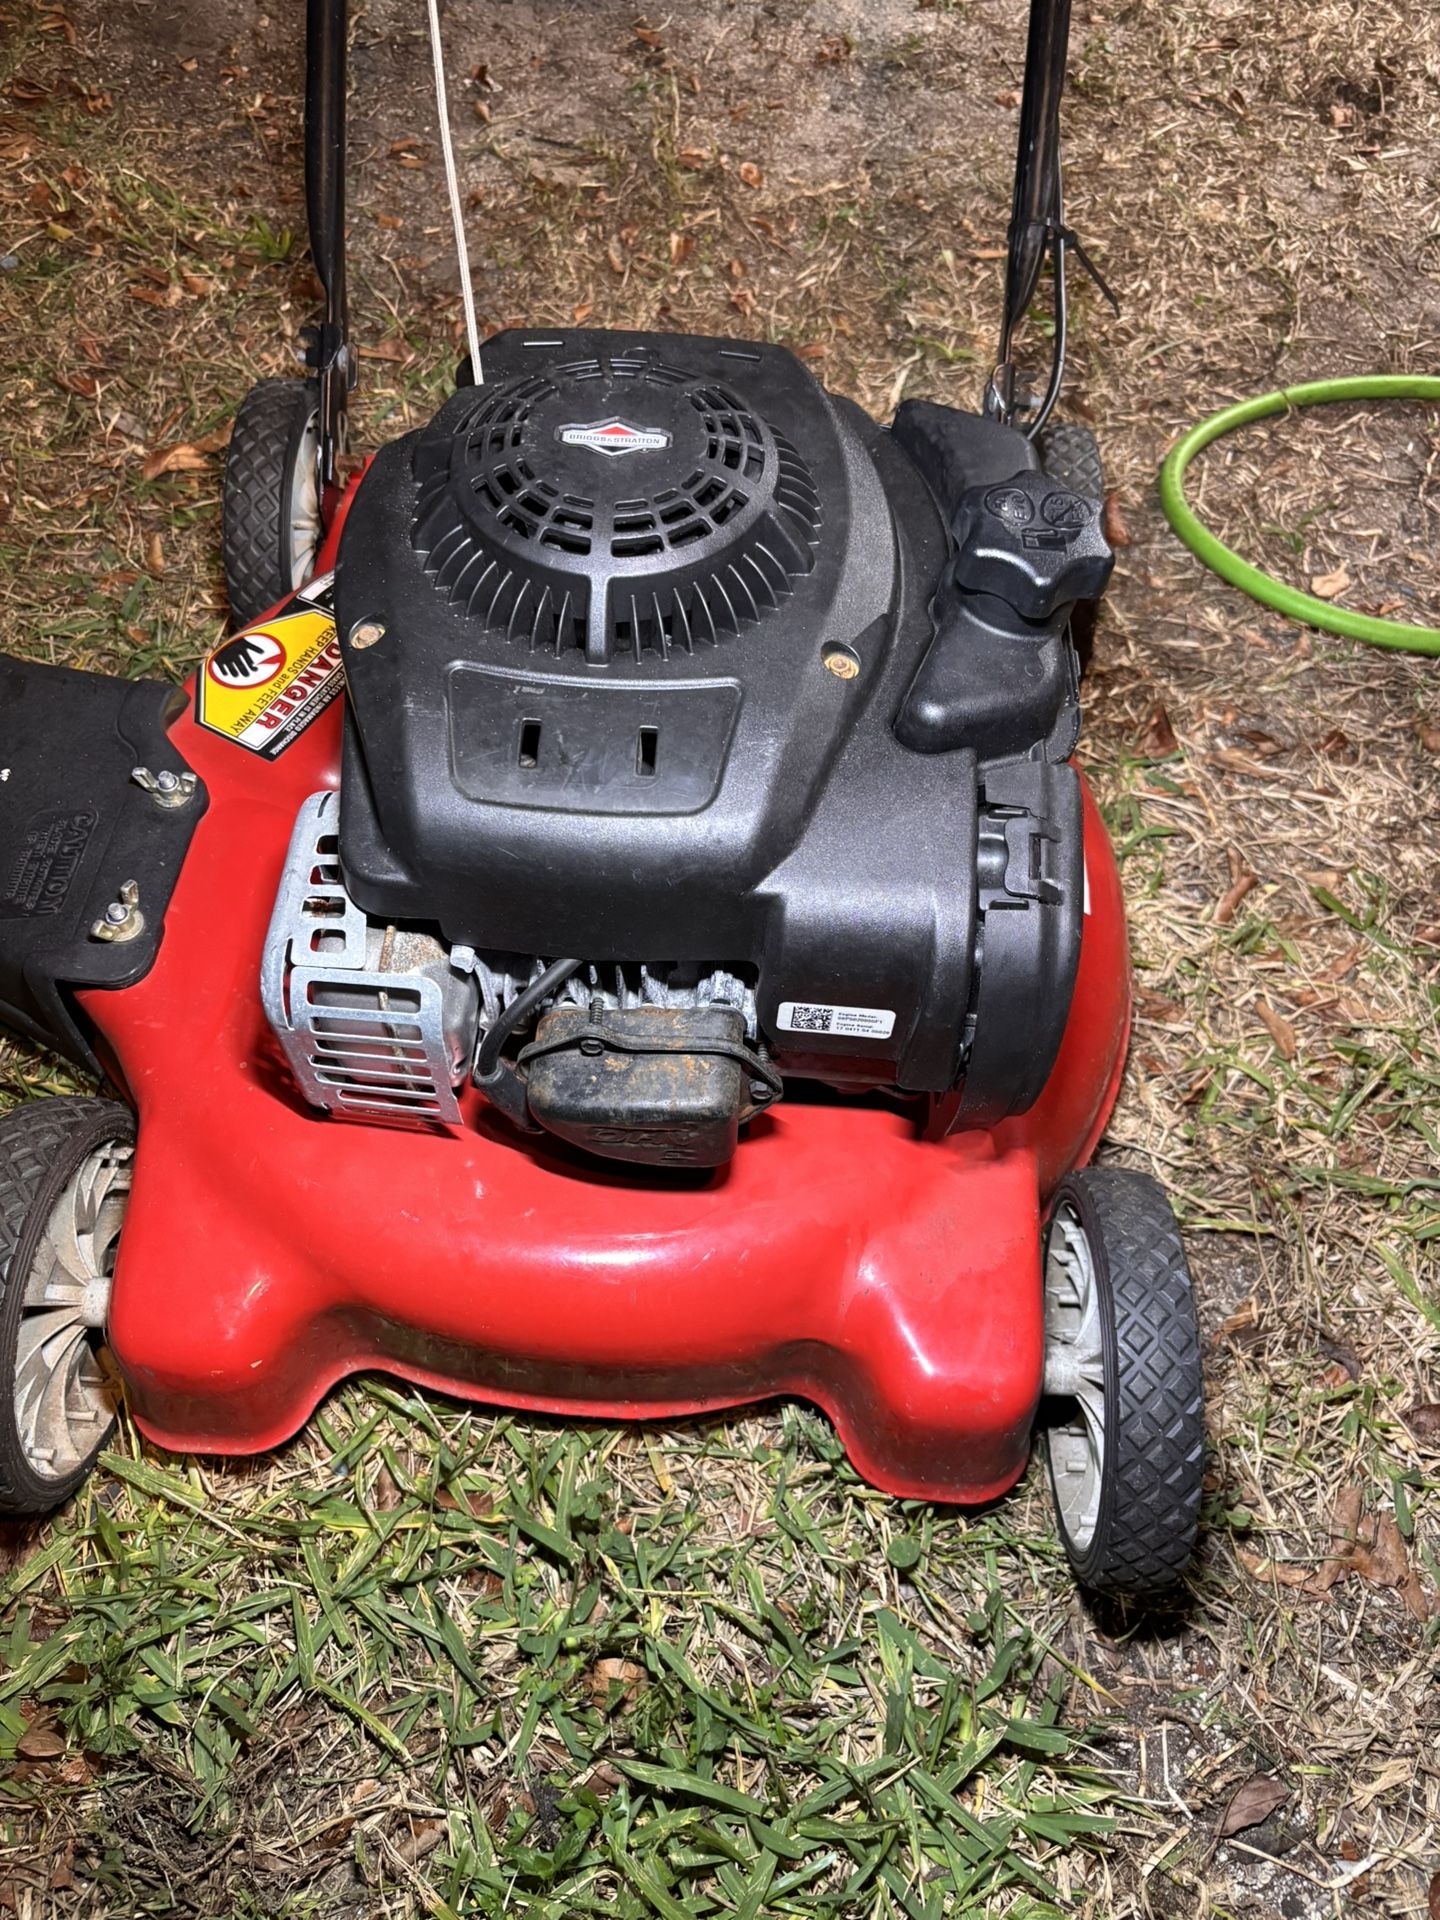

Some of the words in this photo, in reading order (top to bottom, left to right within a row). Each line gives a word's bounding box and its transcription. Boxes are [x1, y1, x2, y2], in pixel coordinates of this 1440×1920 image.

[313, 623, 337, 649] KEEP
[286, 644, 318, 677] HANDS
[254, 640, 344, 733] DANGER
[271, 672, 290, 692] and
[328, 676, 348, 696] NLESS
[252, 687, 276, 711] FEET
[230, 707, 256, 734] AWAY
[36, 811, 96, 913] CAUTION
